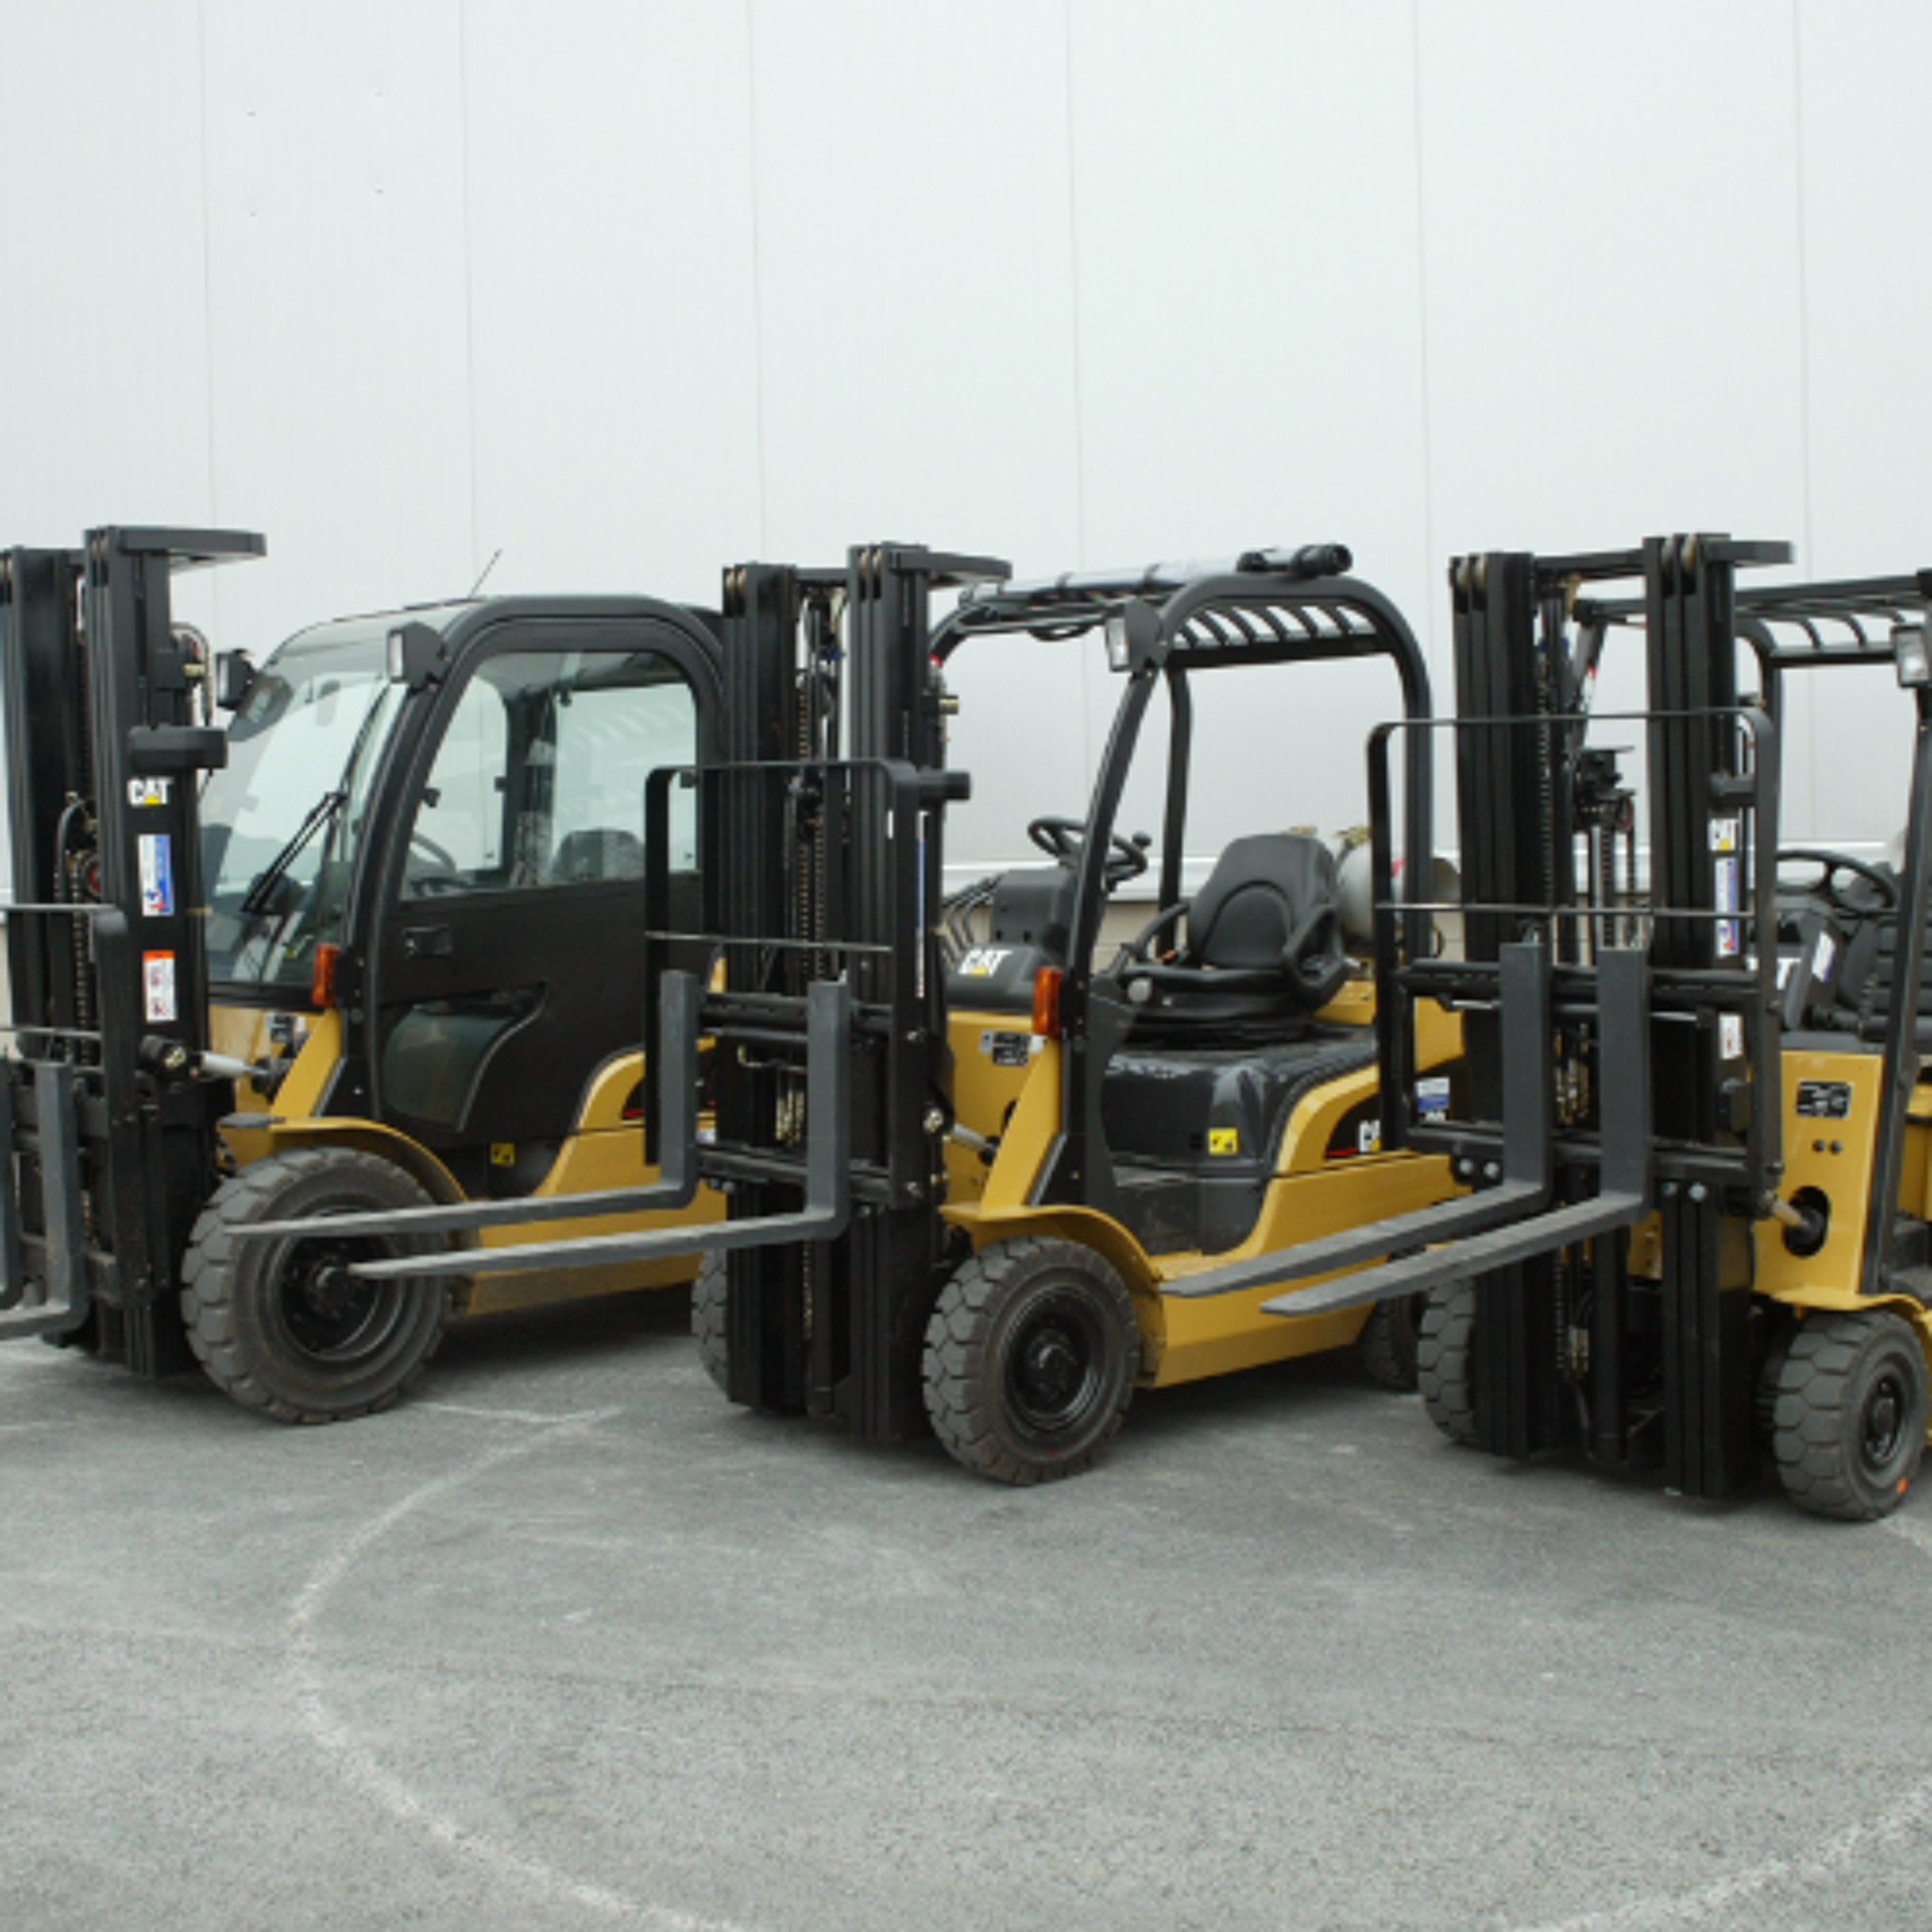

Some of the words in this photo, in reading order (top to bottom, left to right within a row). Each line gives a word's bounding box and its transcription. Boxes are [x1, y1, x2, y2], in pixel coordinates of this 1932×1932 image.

[127, 776, 175, 806] CAT
[958, 948, 1013, 976] CAT
[1359, 1121, 1380, 1152] CA
